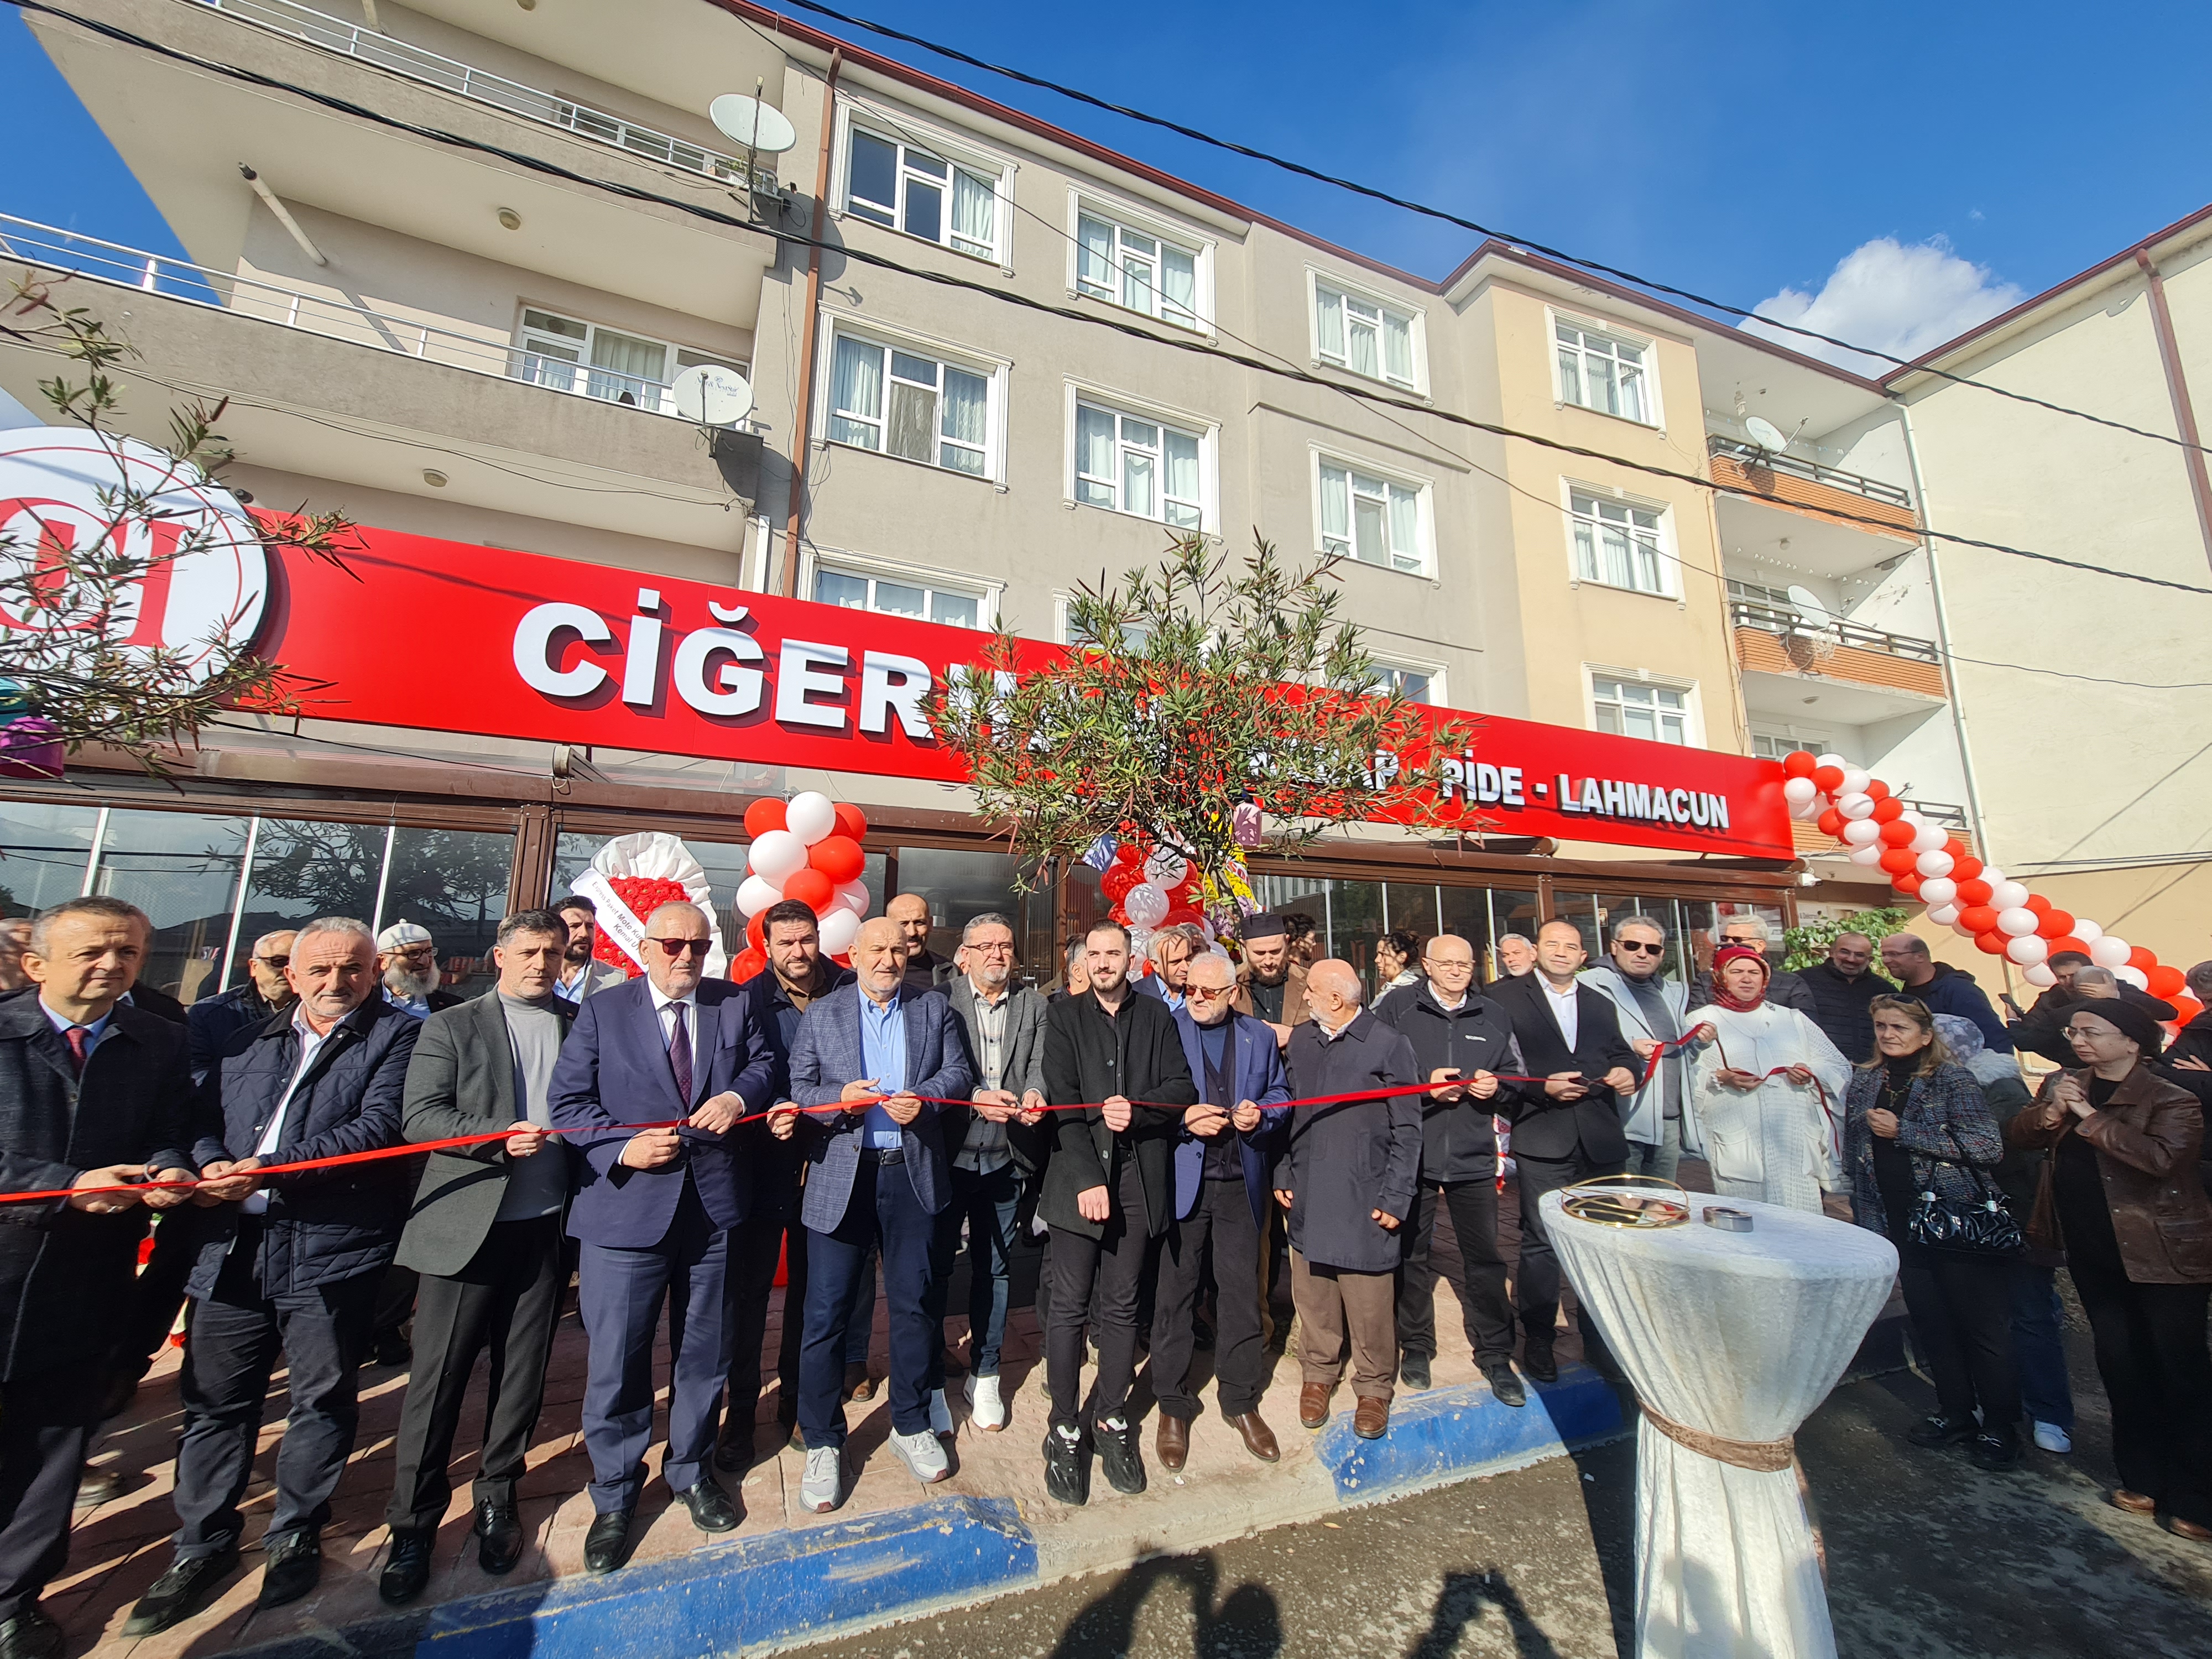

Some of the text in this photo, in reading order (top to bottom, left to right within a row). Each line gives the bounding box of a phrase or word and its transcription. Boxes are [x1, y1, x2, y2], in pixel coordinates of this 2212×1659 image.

[1441, 749, 1526, 805] PİDE
[1559, 774, 1730, 828] LAHMACUN
[605, 899, 619, 915] Paket
[617, 913, 633, 930] Moto
[631, 928, 643, 941] Kur
[613, 923, 631, 943] Kemal
